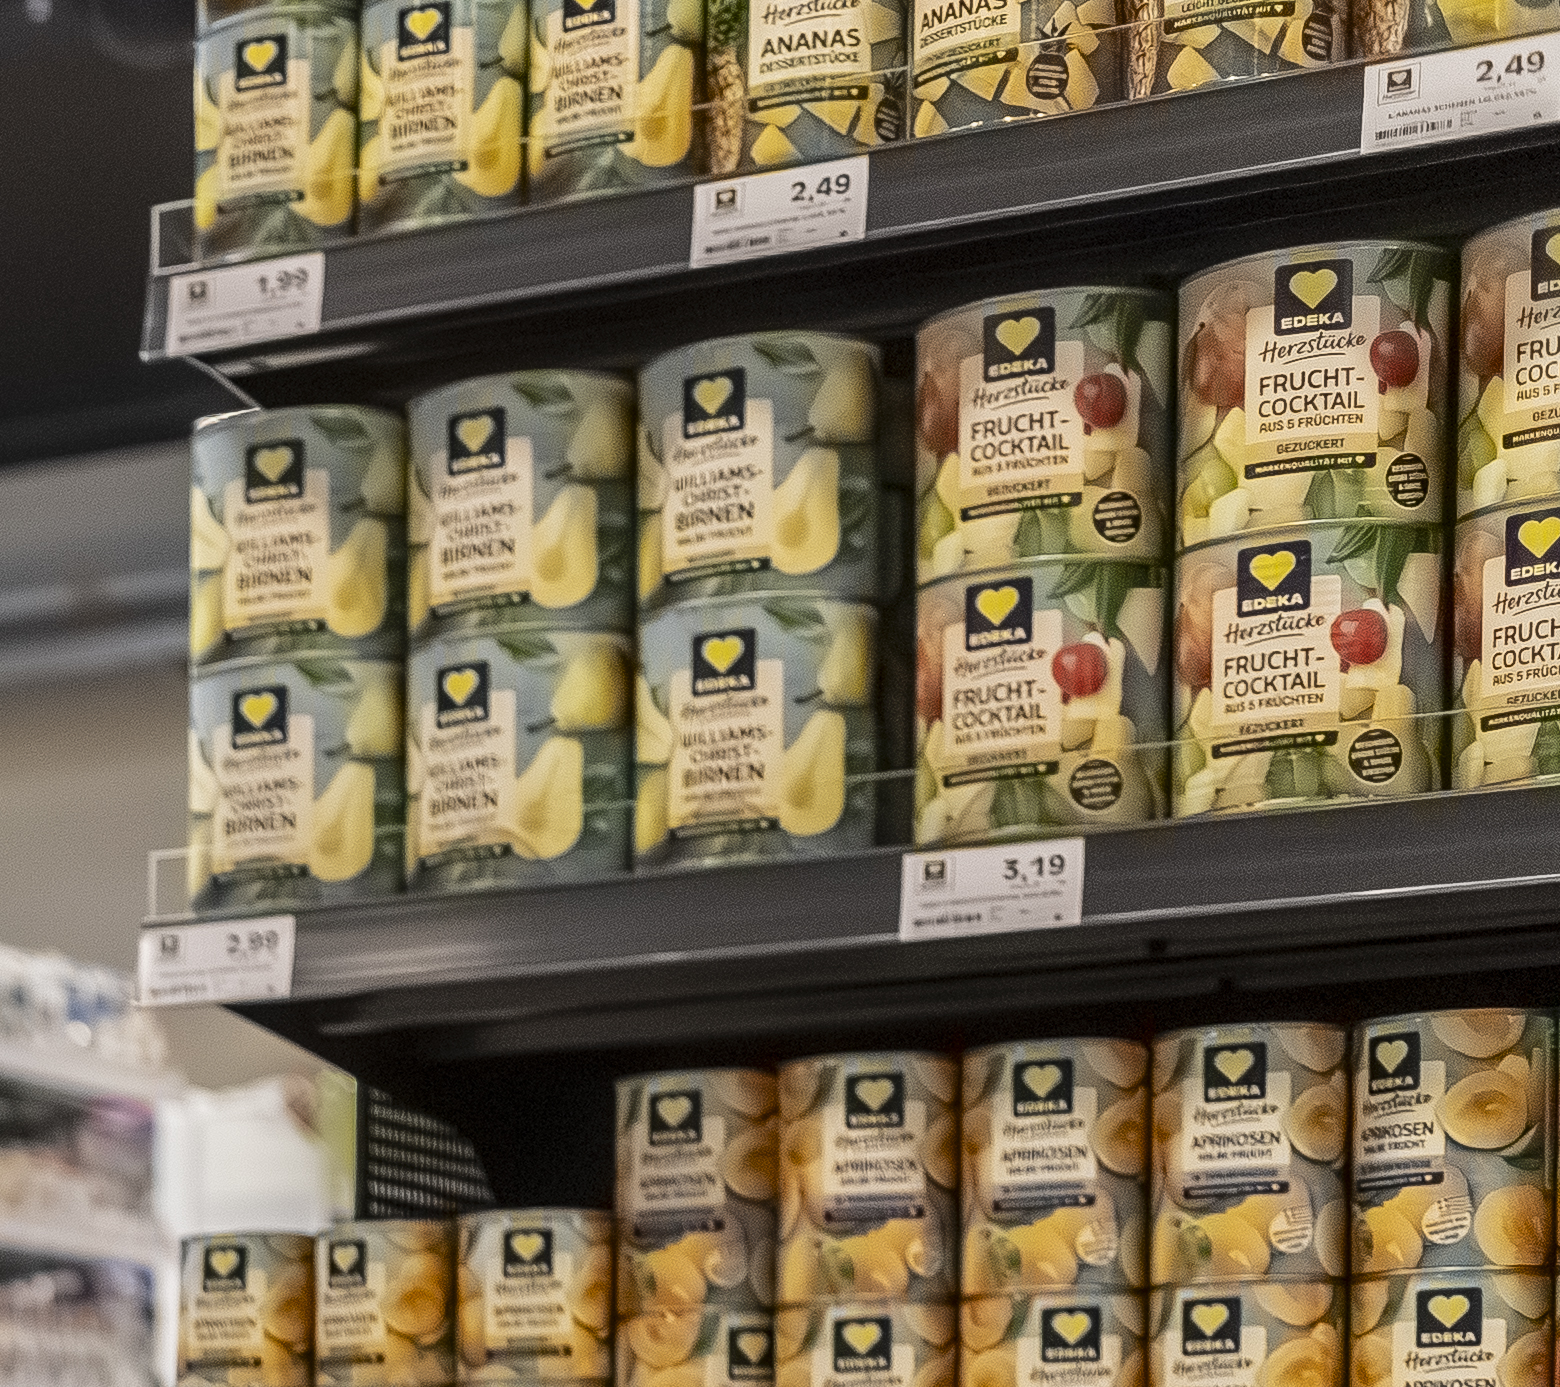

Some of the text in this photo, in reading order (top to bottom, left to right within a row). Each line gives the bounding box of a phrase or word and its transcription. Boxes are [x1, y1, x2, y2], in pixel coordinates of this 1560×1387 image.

[760, 28, 861, 58] ANANAS
[1476, 50, 1546, 83] 2,49
[790, 173, 851, 204] 2,49
[1280, 312, 1345, 330] EDEKA
[1258, 330, 1367, 363] Herzstücke
[1259, 367, 1366, 396] FRUCHT-
[1258, 391, 1366, 418] COCKTAIL
[970, 410, 1071, 442] FRUCHT-
[1259, 413, 1364, 434] AUS 5 FRÜCHTEN
[970, 433, 1070, 463] COCKTAIL
[1276, 438, 1346, 454] GEZUCKERT
[1510, 562, 1560, 580] EDEK
[1242, 593, 1304, 612] EDEKA
[1224, 613, 1326, 644] Herzstücke
[1224, 647, 1325, 677] FRUCHT-
[953, 679, 1047, 709] FRUCHT-
[1224, 671, 1326, 699] COCKTAIL
[952, 704, 1047, 732] COCKTAIL
[1002, 853, 1066, 883] 3,19
[1421, 1331, 1476, 1344] EDEKA
